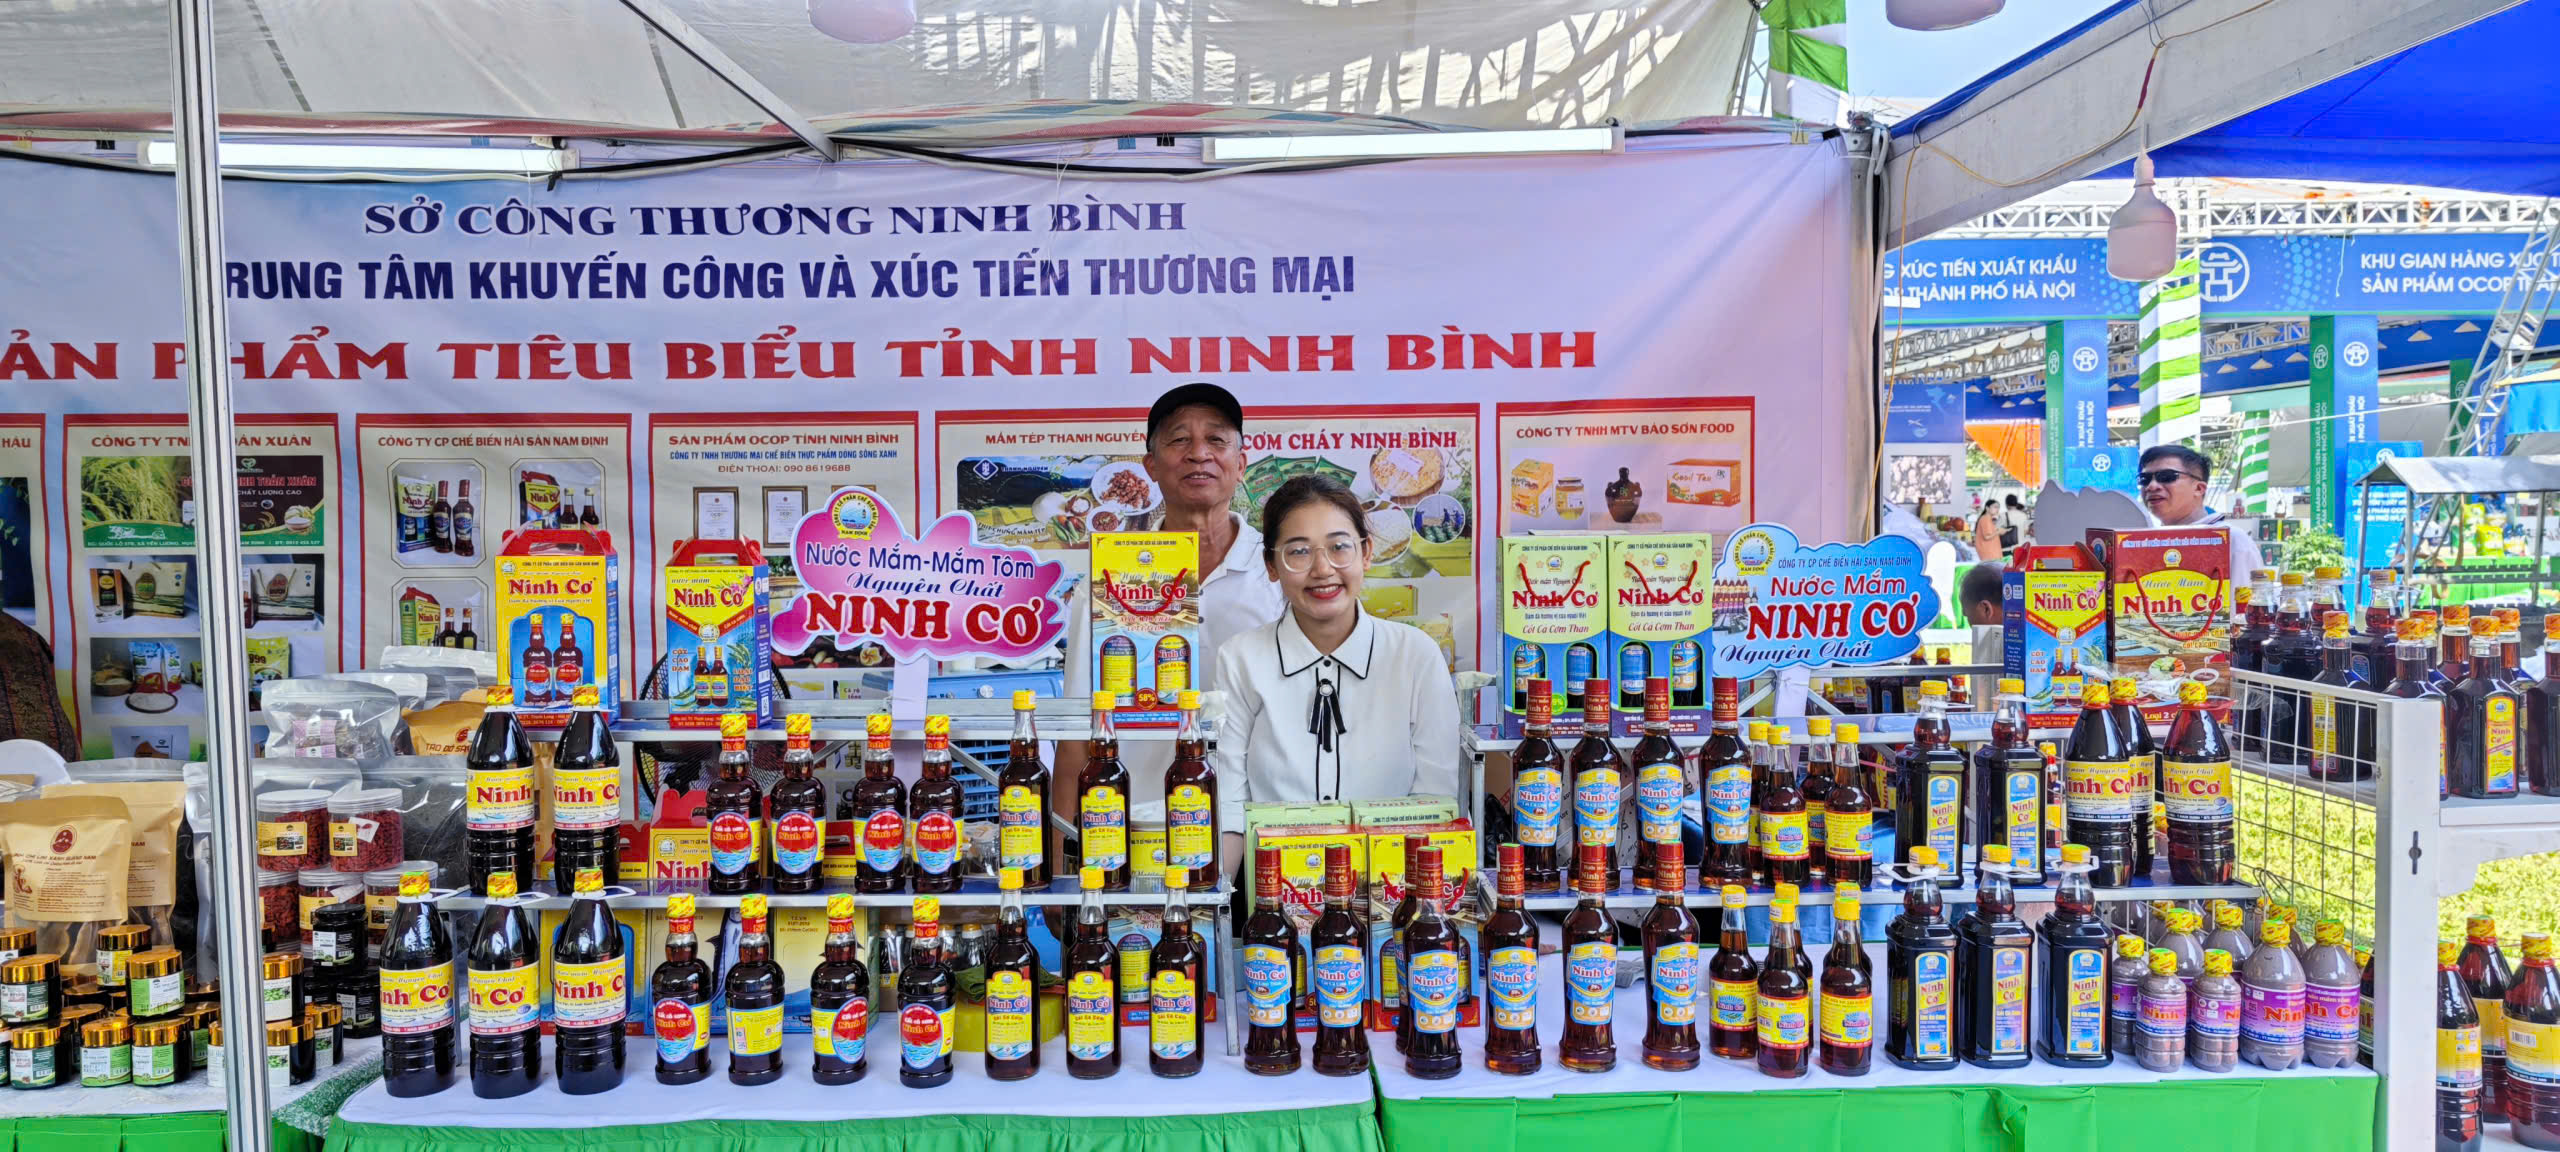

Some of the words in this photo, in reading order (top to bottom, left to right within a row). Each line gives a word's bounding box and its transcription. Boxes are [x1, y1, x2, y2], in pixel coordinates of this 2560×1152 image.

[365, 195, 443, 235] SỞ
[458, 197, 613, 236] CÔNG
[630, 201, 872, 236] THƯƠNG
[889, 203, 1032, 234] NINH
[1051, 195, 1186, 233] BÌNH
[1902, 259, 1936, 278] XÚC
[1942, 258, 1976, 277] TIẾN
[1981, 256, 2025, 276] XUẤT
[2029, 253, 2077, 275] KHẨU
[2361, 253, 2395, 269] KHU
[2400, 253, 2446, 268] GIAN
[2451, 248, 2504, 268] HÀNG
[226, 261, 341, 298] RUNG
[359, 254, 451, 298] TÂM
[470, 251, 646, 299] KHUYẾN
[662, 255, 783, 299] CÔNG
[801, 255, 861, 298] VÀ
[871, 252, 957, 298] XÚC
[974, 248, 1069, 297] TIẾN
[1084, 255, 1256, 296] THƯƠNG
[1272, 255, 1354, 301] MẠI
[1908, 282, 1965, 301] THÀNH
[1971, 280, 2008, 300] PHỐ
[2012, 282, 2038, 300] HÀ
[2043, 282, 2075, 300] NỘI
[2362, 274, 2397, 293] SẢN
[2402, 274, 2451, 292] PHẨM
[0, 329, 118, 380] ẢN
[153, 326, 408, 380] PHẨM
[437, 335, 633, 379] TIÊU
[664, 325, 856, 379] BIỂU
[885, 328, 1098, 378] TỈNH
[1129, 335, 1355, 373] NINH
[1387, 325, 1597, 371] BÌNH
[986, 432, 1016, 444] MẮM
[1020, 432, 1044, 444] TÉP
[1048, 433, 1092, 443] THANH
[1516, 425, 1552, 438] CÔNG
[1555, 426, 1571, 436] TY
[1575, 425, 1608, 436] TNHH
[1610, 425, 1637, 435] MTV
[1642, 422, 1668, 434] BẢO
[1700, 423, 1734, 433] FOOD
[92, 435, 135, 447] CÔNG
[140, 437, 161, 447] TY
[166, 437, 189, 447] TN
[266, 435, 311, 447] XUÂN
[378, 435, 412, 446] CÔNG
[417, 437, 431, 446] TY
[435, 437, 449, 446] CP
[452, 433, 474, 446] CHẾ
[476, 433, 501, 446] BIẾN
[505, 434, 524, 446] HẢI
[527, 434, 553, 446] SẢN
[553, 436, 580, 446] NAM
[581, 436, 608, 447] ĐỊNH
[669, 433, 700, 445] SẢN
[704, 432, 745, 445] PHẨM
[750, 435, 789, 444] OCOP
[793, 433, 824, 444] TỈNH
[830, 434, 862, 444] NINH
[866, 433, 898, 444] BÌNH
[1242, 431, 1281, 450] CƠM
[1289, 429, 1343, 449] CHÁY
[1351, 432, 1403, 449] NINH
[1408, 427, 1457, 448] BÌNH
[670, 449, 689, 460] CÔNG
[691, 452, 699, 460] TY
[701, 451, 719, 459] TNHH
[721, 450, 747, 460] THƯƠNG
[879, 450, 897, 458] XANH
[784, 464, 802, 472] 090
[806, 543, 861, 567] Nước
[869, 543, 984, 576] Mắm-Mắm
[992, 556, 1034, 578] Tôm
[1799, 559, 1806, 568] TY
[1808, 559, 1817, 568] CP
[1880, 557, 1894, 566] NAM
[509, 579, 559, 596] Ninh
[566, 578, 593, 595] Cơ
[847, 572, 942, 594] Nguyên
[949, 577, 1004, 598] Chất
[1771, 576, 1836, 597] Nước
[1844, 569, 1906, 595] Mắm
[673, 588, 715, 607] Ninh
[720, 587, 745, 607] Cơ
[1104, 584, 1153, 600] Ninh
[1512, 590, 1563, 608] Ninh
[1571, 590, 1598, 607] Cơ
[1618, 588, 1670, 606] Ninh
[1677, 586, 1704, 605] Cơ
[2034, 592, 2073, 611] Ninh
[2077, 592, 2097, 611] Cơ
[807, 593, 950, 640] NINH
[966, 599, 1043, 644] CƠ
[1747, 602, 1852, 640] NINH
[1863, 593, 1920, 636] CƠ
[1568, 624, 1589, 633] Than
[1674, 622, 1694, 631] Than
[1721, 644, 1812, 664] Nguyên
[1819, 640, 1873, 658] Chất
[1138, 694, 1155, 702] 58%
[477, 784, 531, 803] Ninh
[1519, 790, 1546, 801] Ninh
[1641, 787, 1667, 798] Ninh
[2188, 780, 2221, 795] Cơ
[1579, 791, 1605, 801] Ninh
[2012, 801, 2034, 813] Ninh
[1318, 969, 1344, 980] Ninh
[1493, 971, 1521, 982] Ninh
[1572, 965, 1601, 977] Ninh
[1921, 981, 1944, 995] Ninh
[1998, 978, 2020, 991] Ninh
[2073, 980, 2098, 992] Ninh
[490, 987, 525, 1006] Cơ
